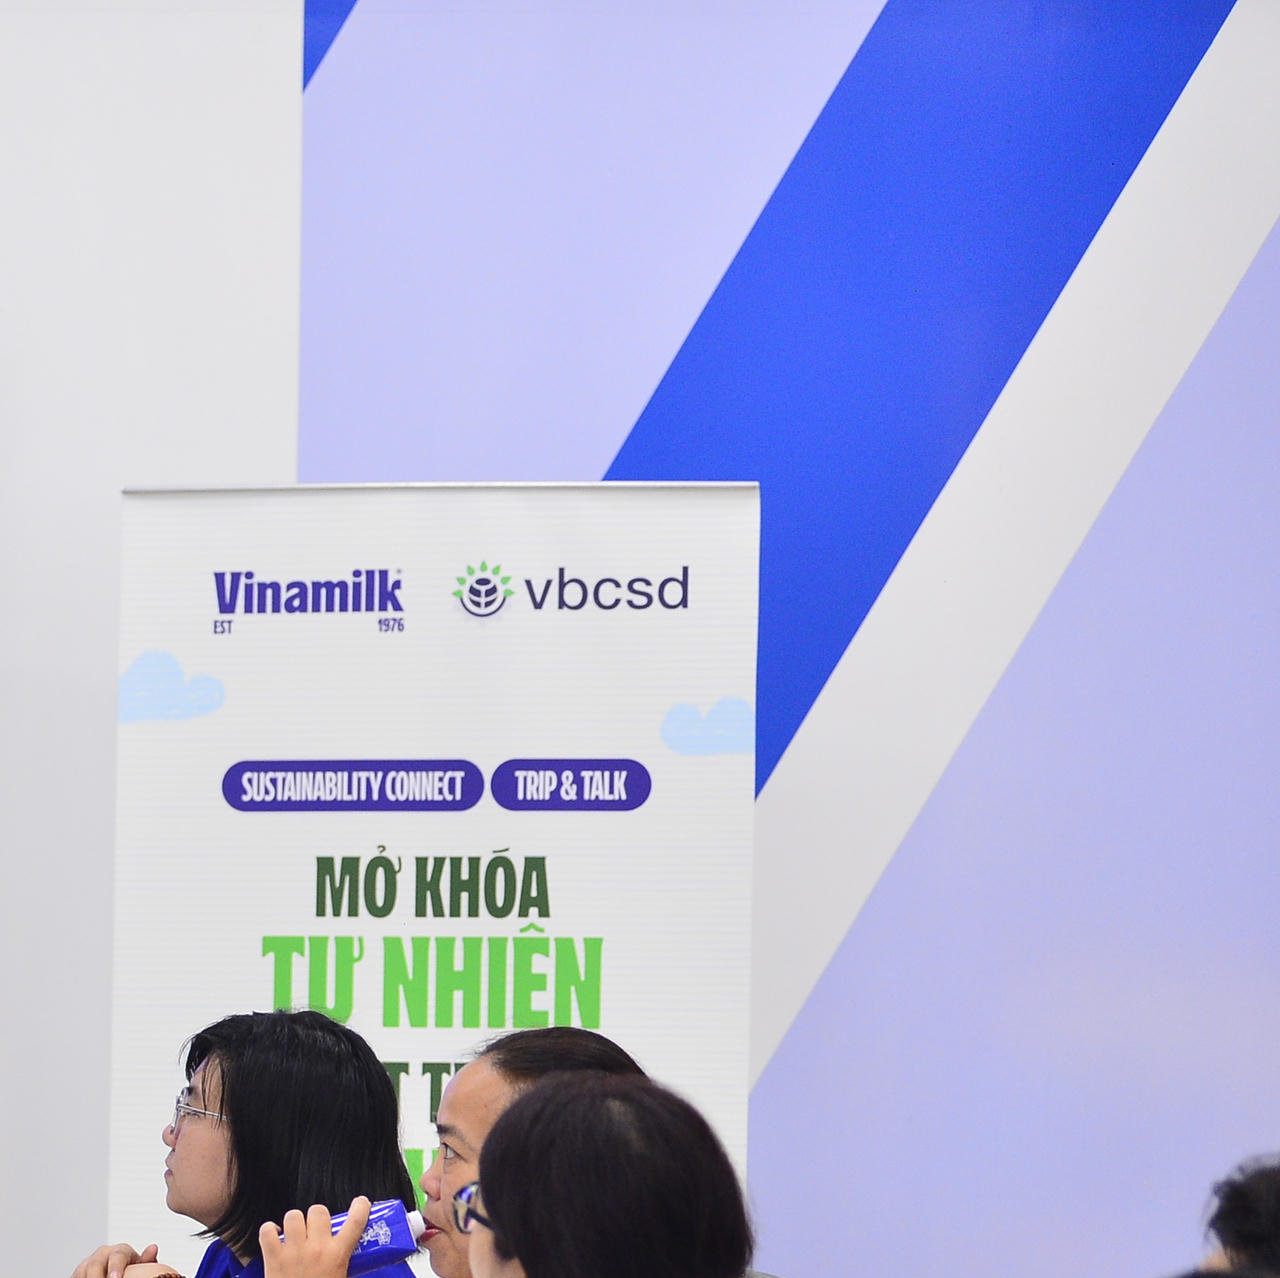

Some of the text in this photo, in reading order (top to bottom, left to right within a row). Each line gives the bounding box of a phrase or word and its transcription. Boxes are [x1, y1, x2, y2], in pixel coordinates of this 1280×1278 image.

[213, 566, 690, 614] Vinamilk vbcsd
[213, 618, 405, 635] EST 1976
[241, 770, 465, 802] SUSTAINABILITY CONNECT
[514, 770, 628, 801] TRIP & TALK
[315, 844, 551, 919] MỞ KHÓA
[382, 923, 604, 1030] NHIÊN
